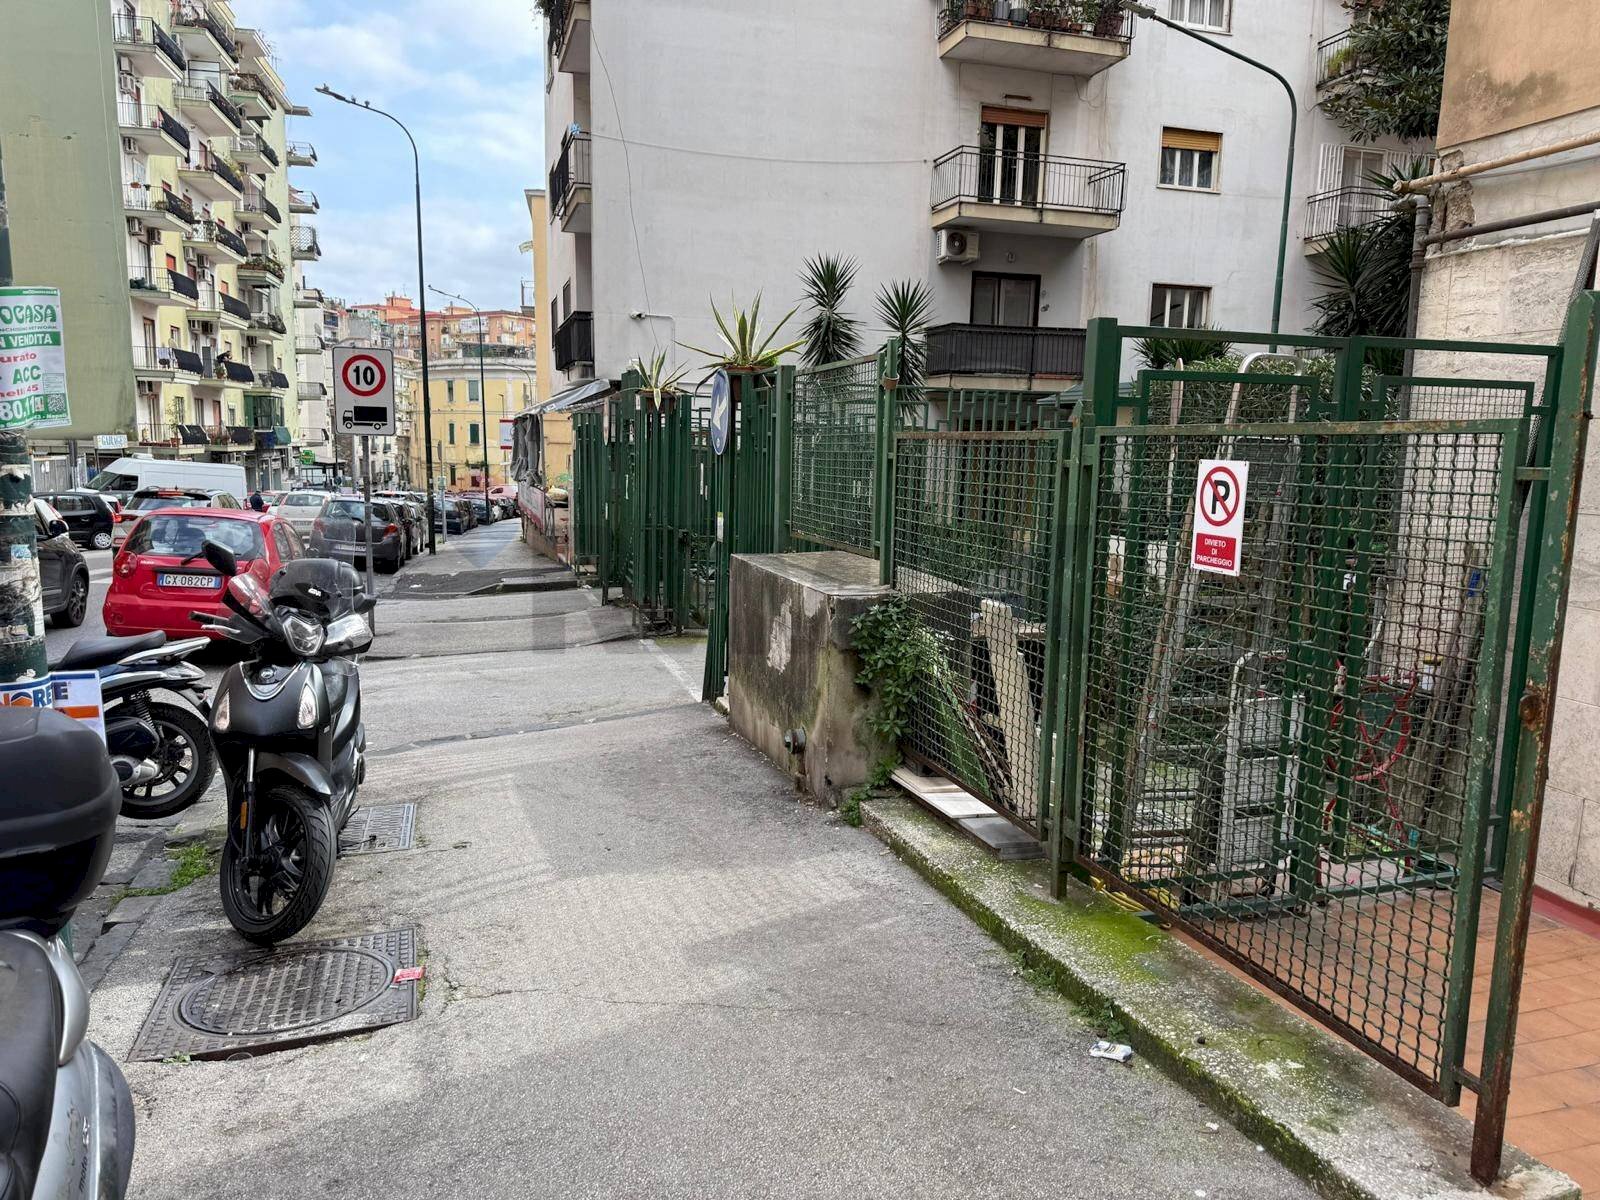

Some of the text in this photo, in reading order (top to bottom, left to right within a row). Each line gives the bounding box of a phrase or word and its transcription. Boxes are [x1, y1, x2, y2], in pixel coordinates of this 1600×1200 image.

[9, 333, 52, 347] VENDITA
[13, 365, 41, 384] ACC
[353, 365, 375, 386] 10
[1204, 538, 1226, 548] DIVIETO
[1196, 554, 1232, 567] PARCHEGGIO
